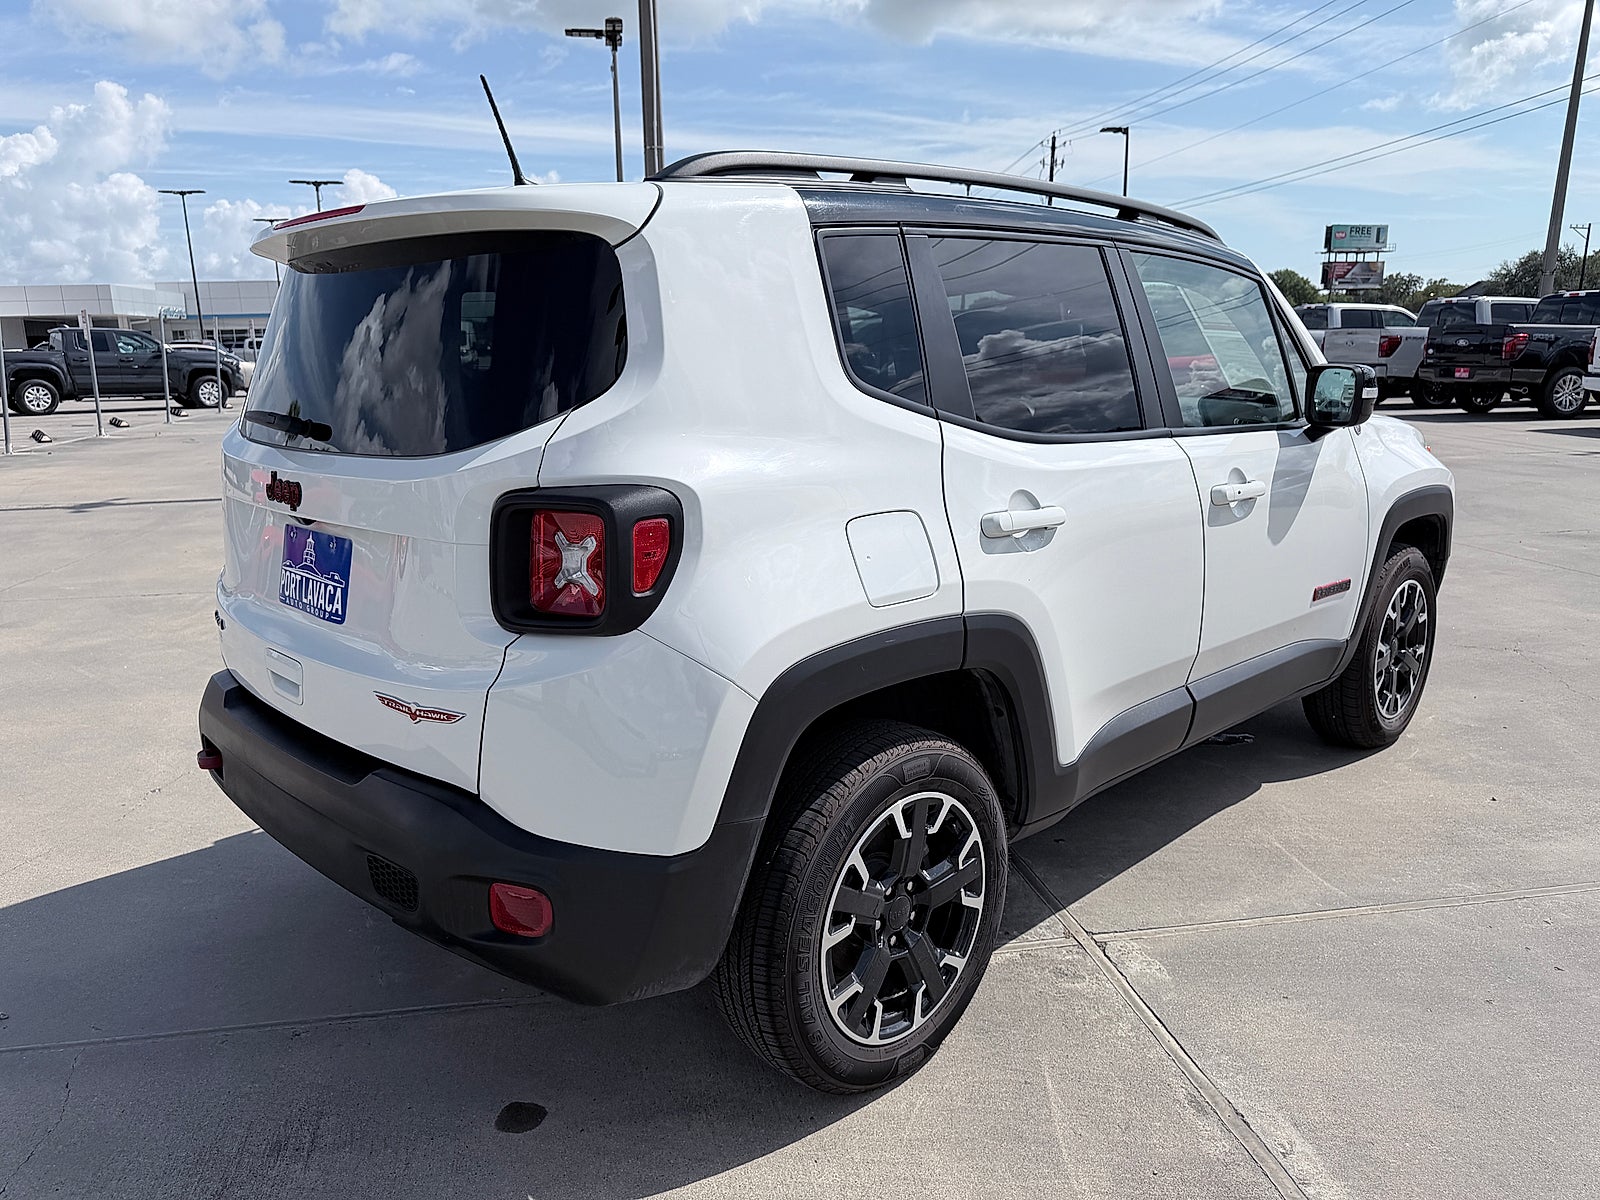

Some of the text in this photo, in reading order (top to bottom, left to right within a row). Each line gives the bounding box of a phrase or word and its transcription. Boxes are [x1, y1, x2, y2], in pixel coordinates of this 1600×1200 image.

[1350, 226, 1372, 236] FREE
[265, 470, 302, 512] Jeep
[280, 568, 342, 615] PORT LAVACA
[286, 596, 330, 619] AUTO GROUP
[415, 710, 448, 720] HAWK
[796, 852, 837, 973] SEASON
